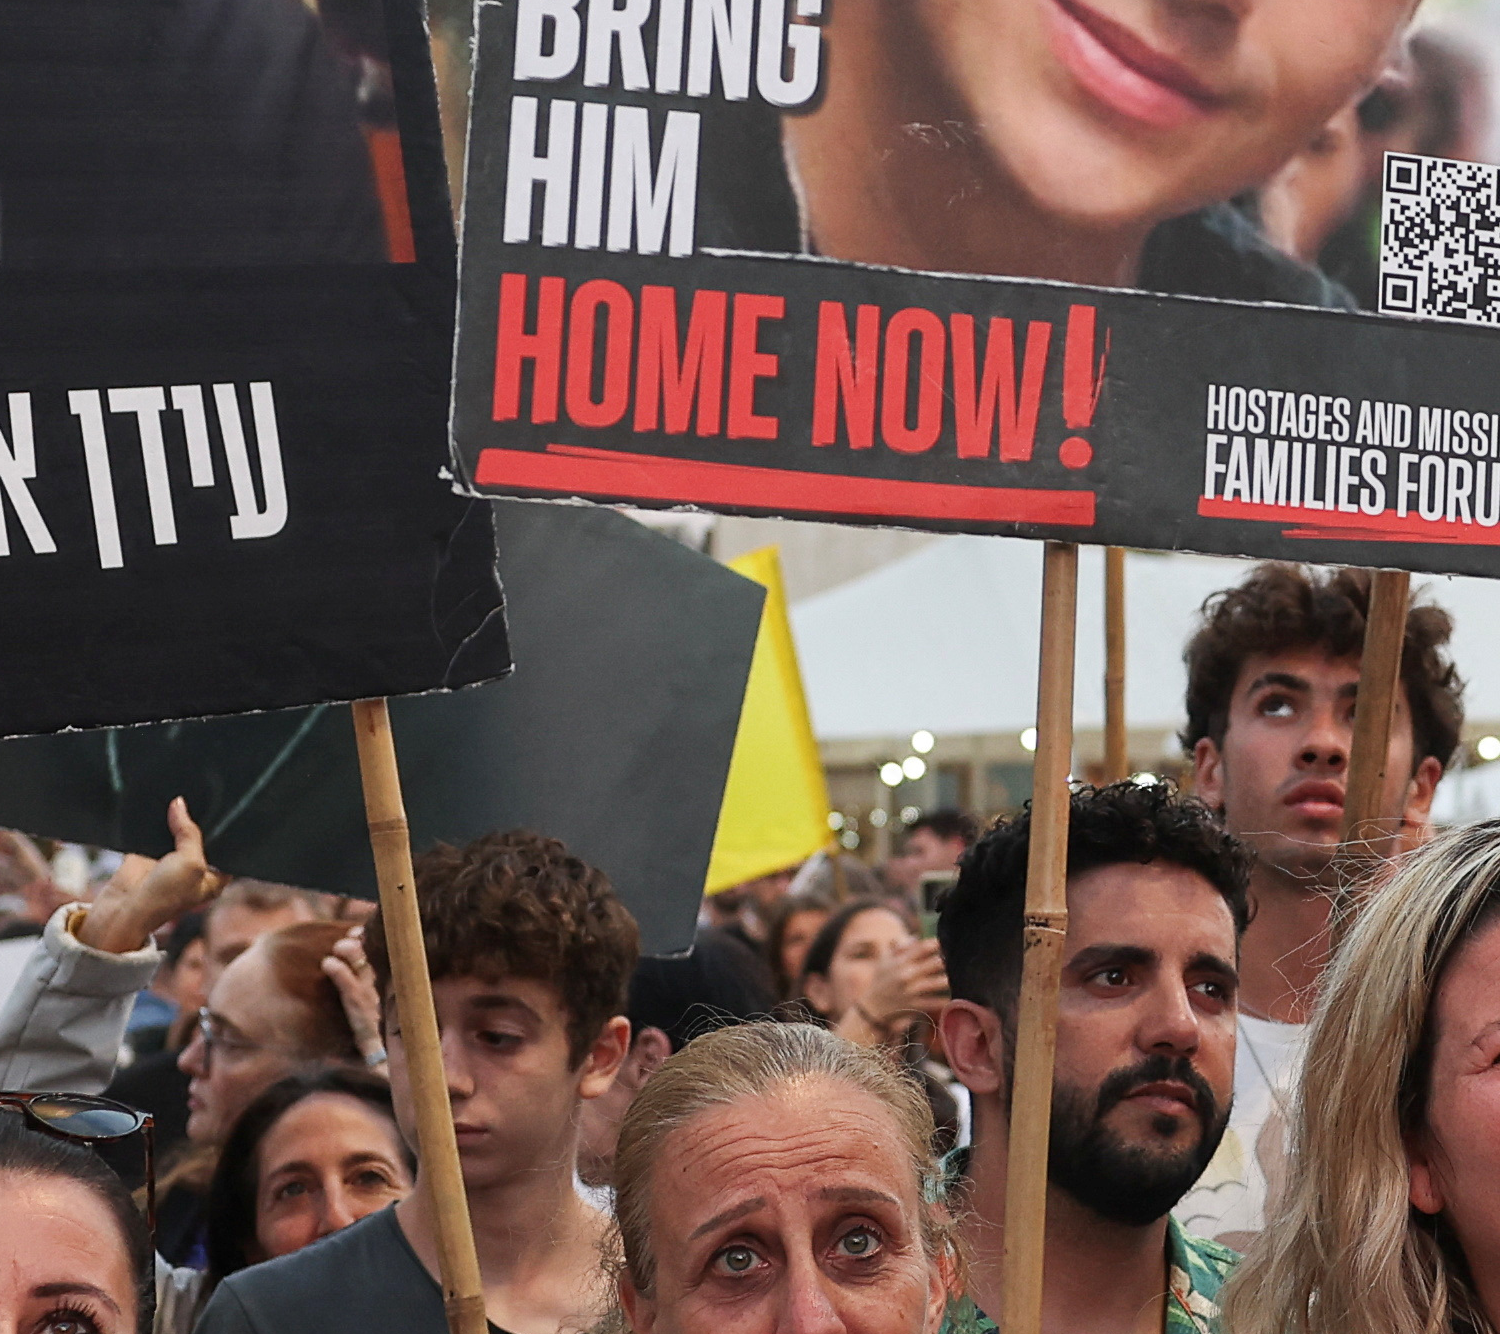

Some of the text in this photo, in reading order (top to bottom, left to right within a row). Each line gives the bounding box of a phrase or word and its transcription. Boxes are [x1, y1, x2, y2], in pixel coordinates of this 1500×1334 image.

[503, 95, 701, 259] HIM
[492, 273, 1110, 470] HOME NOW!
[1206, 384, 1350, 444] HOSTAGES
[1356, 399, 1412, 450] AND
[68, 381, 290, 570] עידן
[1205, 433, 1386, 516] FAMILIES
